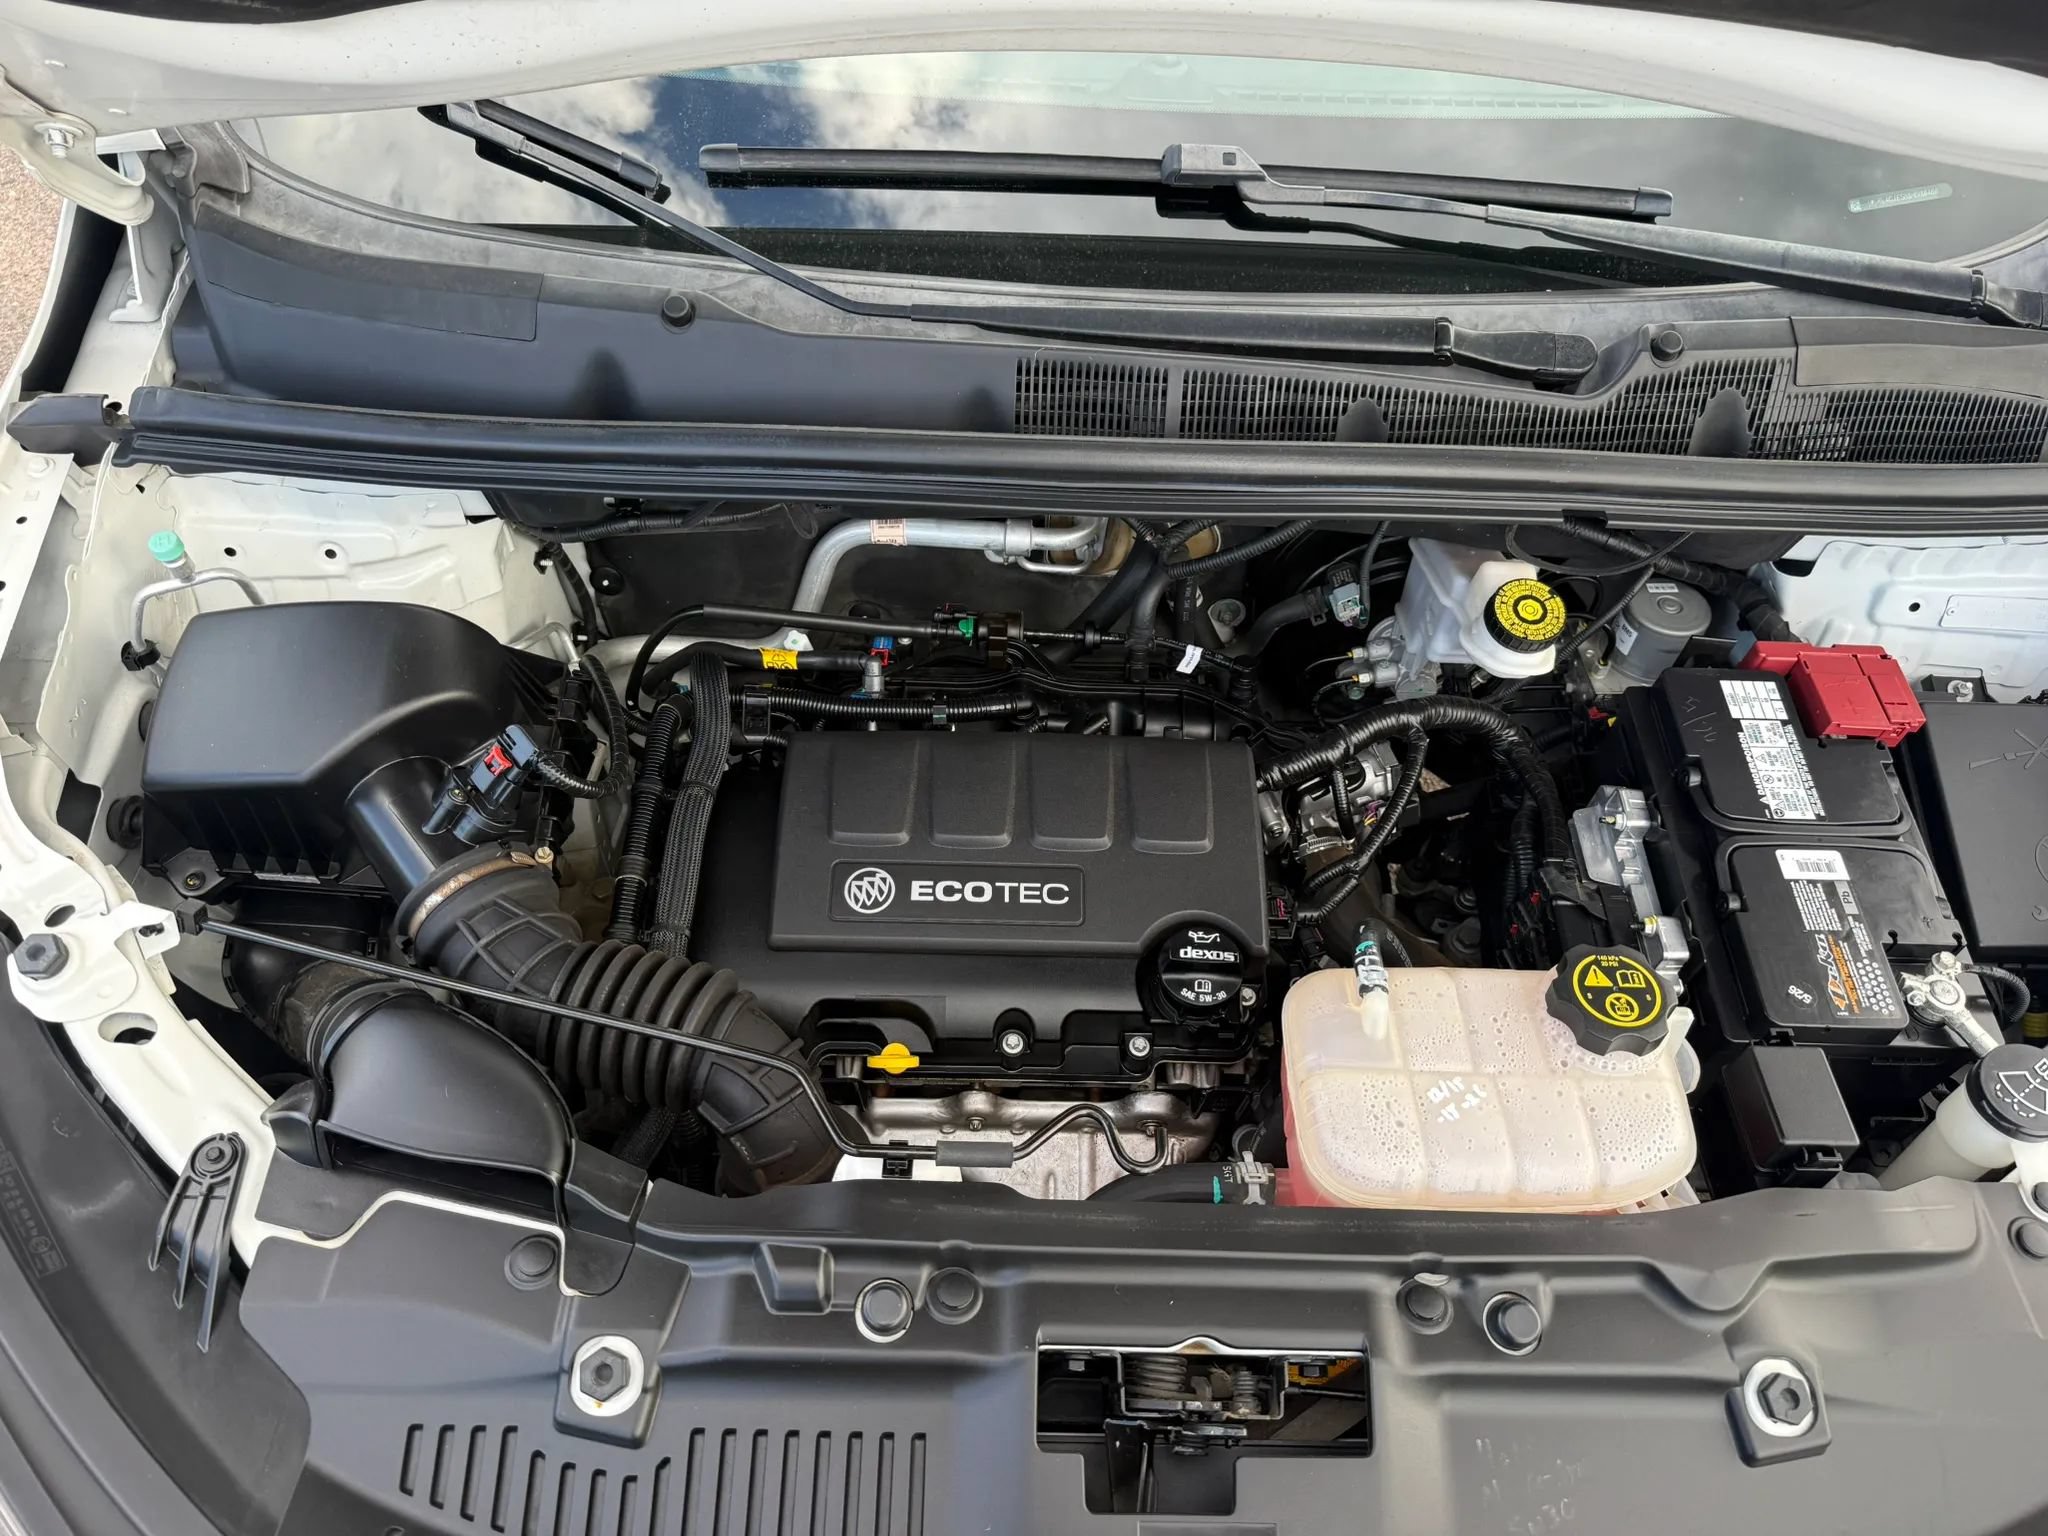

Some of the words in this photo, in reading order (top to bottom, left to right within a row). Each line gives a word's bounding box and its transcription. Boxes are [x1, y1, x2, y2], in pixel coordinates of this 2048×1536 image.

[910, 880, 1070, 905] ECOTEC
[1841, 890, 1853, 904] Pb
[1180, 987, 1197, 1001] SAE
[1199, 990, 1227, 1002] 5W-30
[1788, 985, 1813, 1004] 5/26
